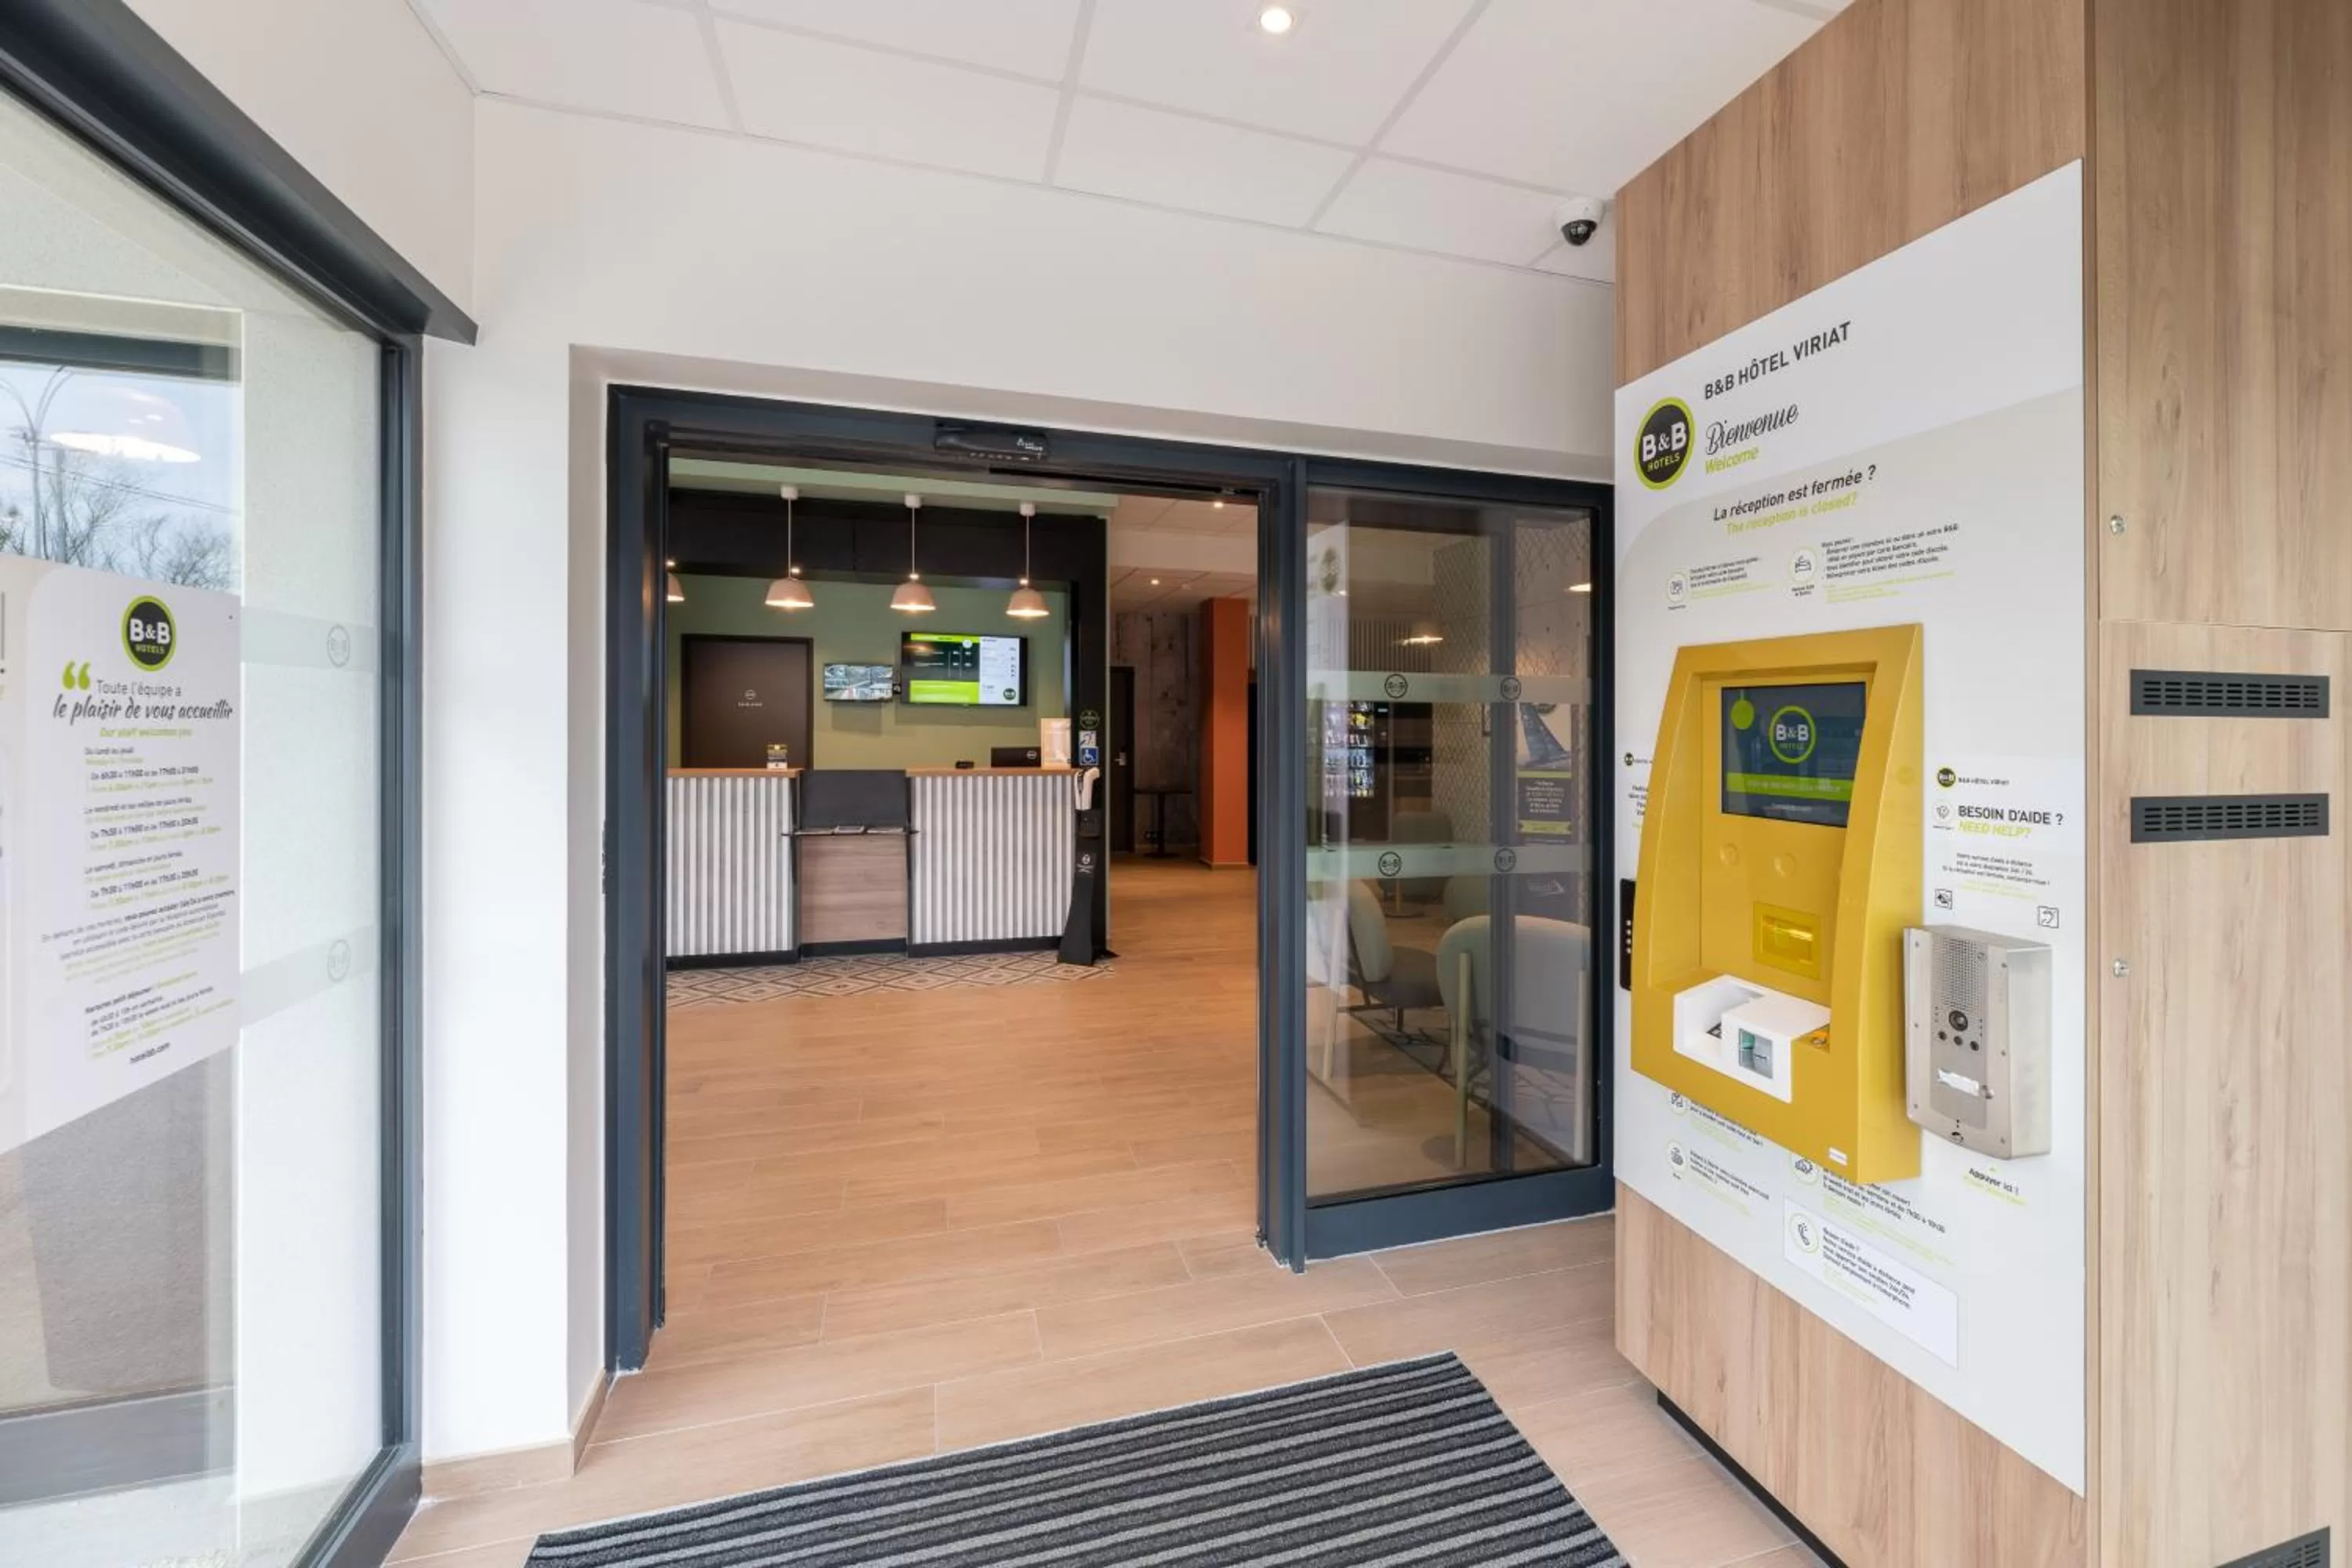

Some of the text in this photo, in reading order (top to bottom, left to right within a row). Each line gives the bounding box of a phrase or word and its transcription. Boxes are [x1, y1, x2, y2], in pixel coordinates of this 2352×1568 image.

[1704, 321, 1851, 400] B&B HÔTEL VIRIAT
[1642, 420, 1688, 463] B&B
[1705, 404, 1799, 456] Bienvenue
[1646, 452, 1681, 472] HOTELS
[1705, 447, 1759, 474] Welcome
[1713, 464, 1877, 521] La réception est fermée ?
[129, 619, 171, 644] B&B
[96, 679, 128, 695] Toute
[132, 681, 173, 699] l'équipe
[53, 693, 233, 726] le plaisir de vous accueillir
[1776, 724, 1809, 741] B&B
[1958, 805, 2064, 826] BESOIN D'AIDE ?
[1958, 821, 1990, 834] NEED
[1992, 825, 2032, 837] HELP?
